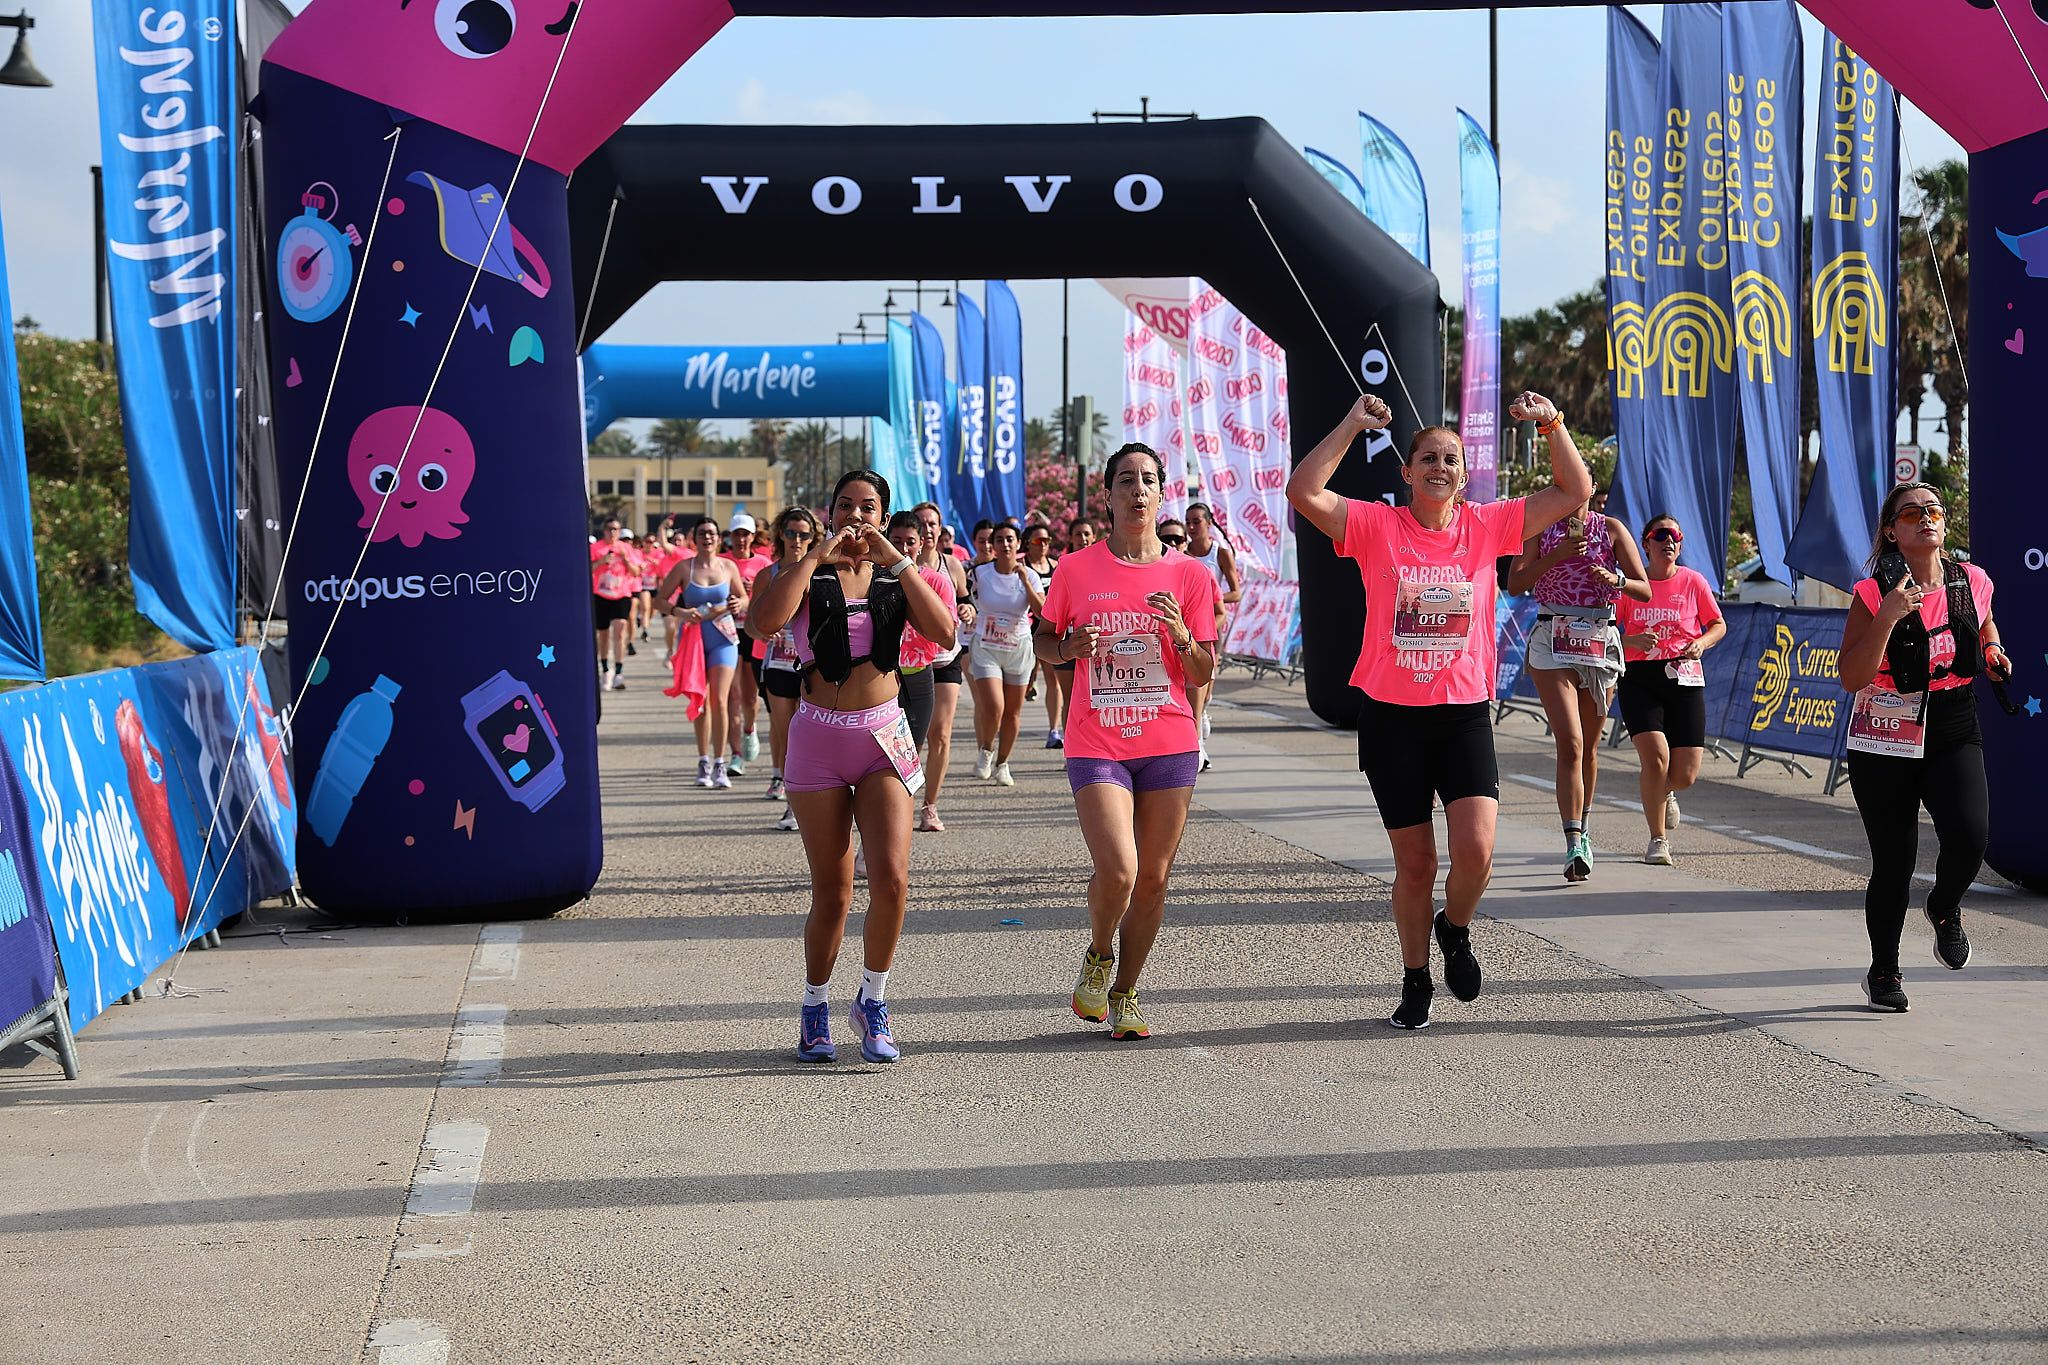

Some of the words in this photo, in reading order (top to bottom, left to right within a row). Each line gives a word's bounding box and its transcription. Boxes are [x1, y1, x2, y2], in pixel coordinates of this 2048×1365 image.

[701, 173, 1164, 215] VOLVO
[1136, 302, 1189, 340] COS
[684, 351, 816, 409] Marlene
[304, 575, 426, 608] octopus
[430, 569, 543, 603] energy
[1088, 591, 1119, 601] OYSHO
[1091, 611, 1160, 633] CARRERA
[1419, 613, 1447, 625] 016
[1634, 608, 1682, 622] CARRERA
[1569, 638, 1591, 647] 016
[1115, 667, 1146, 680] 016
[1100, 696, 1125, 704] OYSHO
[812, 710, 860, 726] NIKE
[863, 702, 897, 725] PRO
[1097, 705, 1160, 728] MUJER
[1784, 687, 1837, 735] Express
[1871, 717, 1900, 730] 016
[1121, 725, 1142, 739] 2026
[1855, 740, 1878, 749] OYSHO
